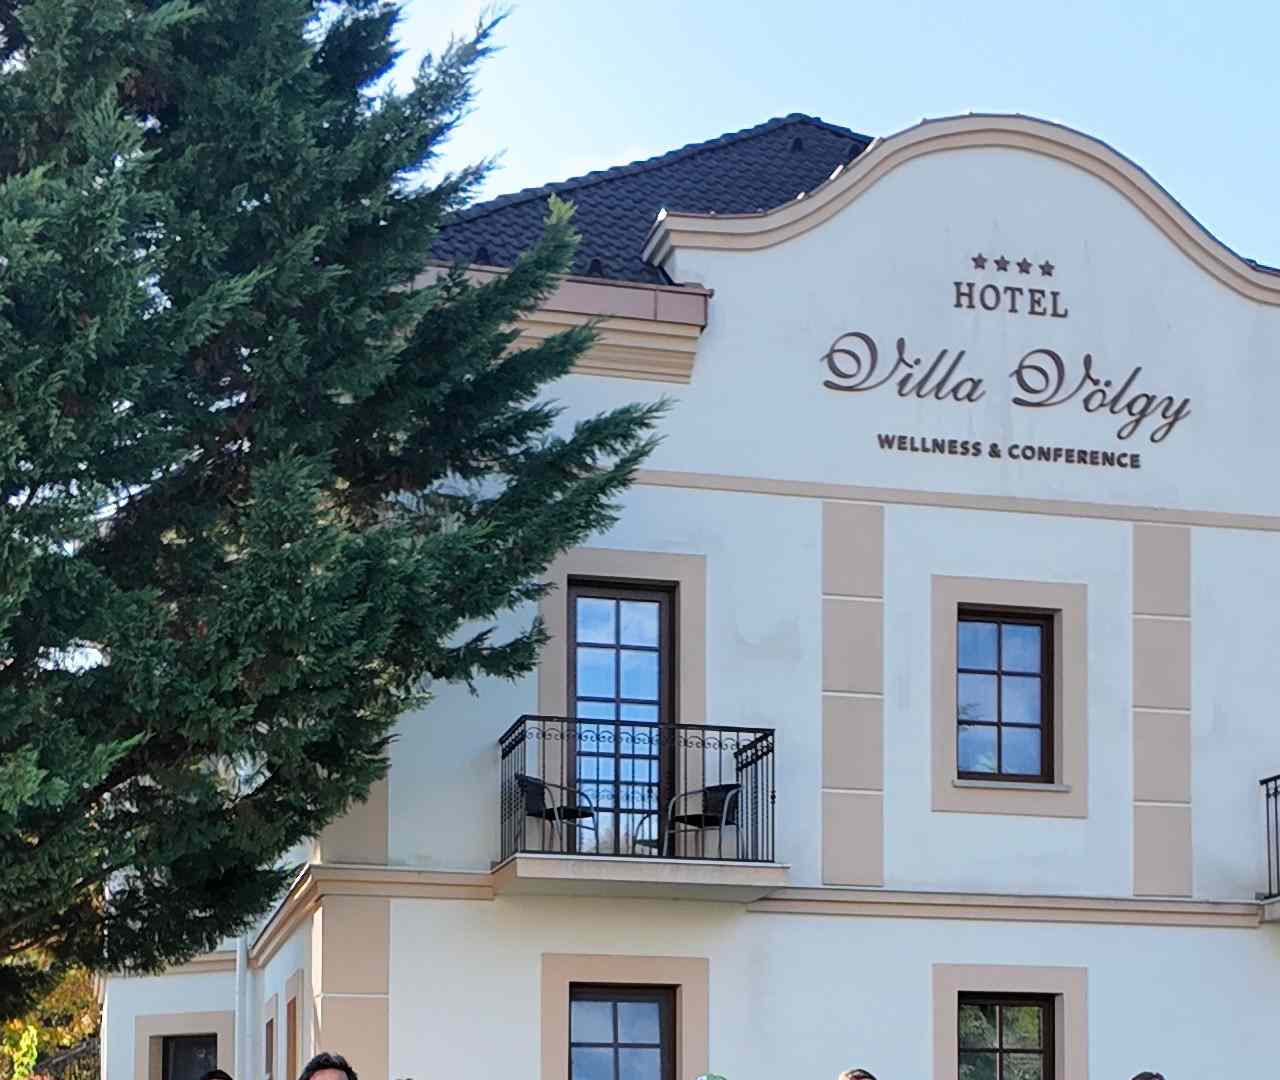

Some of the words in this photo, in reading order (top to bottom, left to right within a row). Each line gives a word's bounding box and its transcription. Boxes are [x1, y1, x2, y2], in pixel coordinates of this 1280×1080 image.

[952, 280, 1069, 318] HOTEL
[819, 331, 987, 404] Villa
[1008, 348, 1192, 444] Völgy
[876, 433, 983, 458] WELLNESS
[987, 442, 1003, 459] &
[1007, 443, 1142, 470] CONFERENCE
